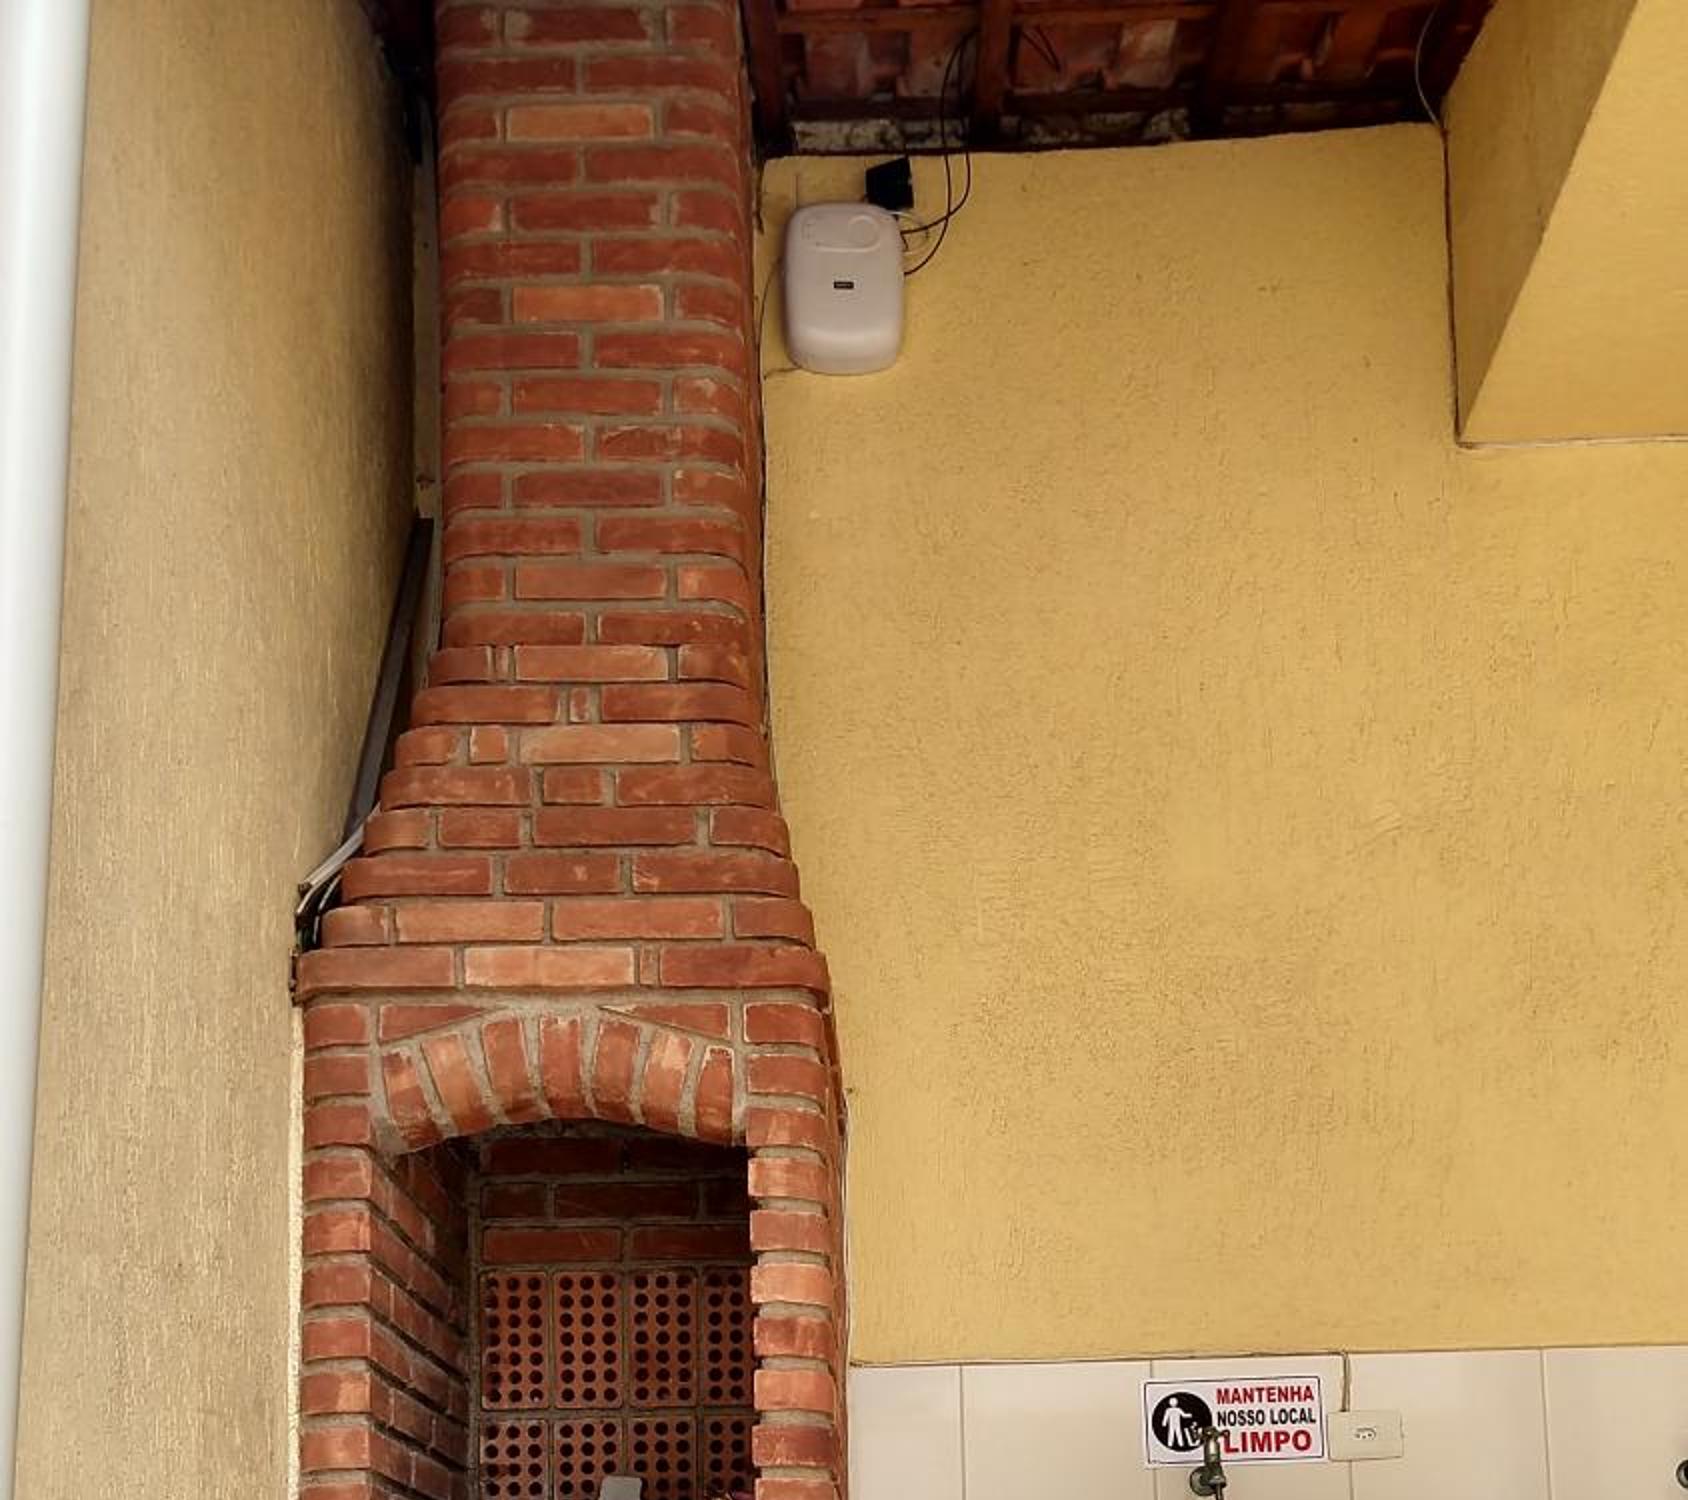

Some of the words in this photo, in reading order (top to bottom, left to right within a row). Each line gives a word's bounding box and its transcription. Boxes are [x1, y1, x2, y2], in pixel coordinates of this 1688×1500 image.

[1216, 1385, 1315, 1405] MANTENHA
[1217, 1409, 1265, 1427] NOSSO
[1269, 1407, 1316, 1425] LOCAL
[1223, 1429, 1312, 1453] LIMPO
